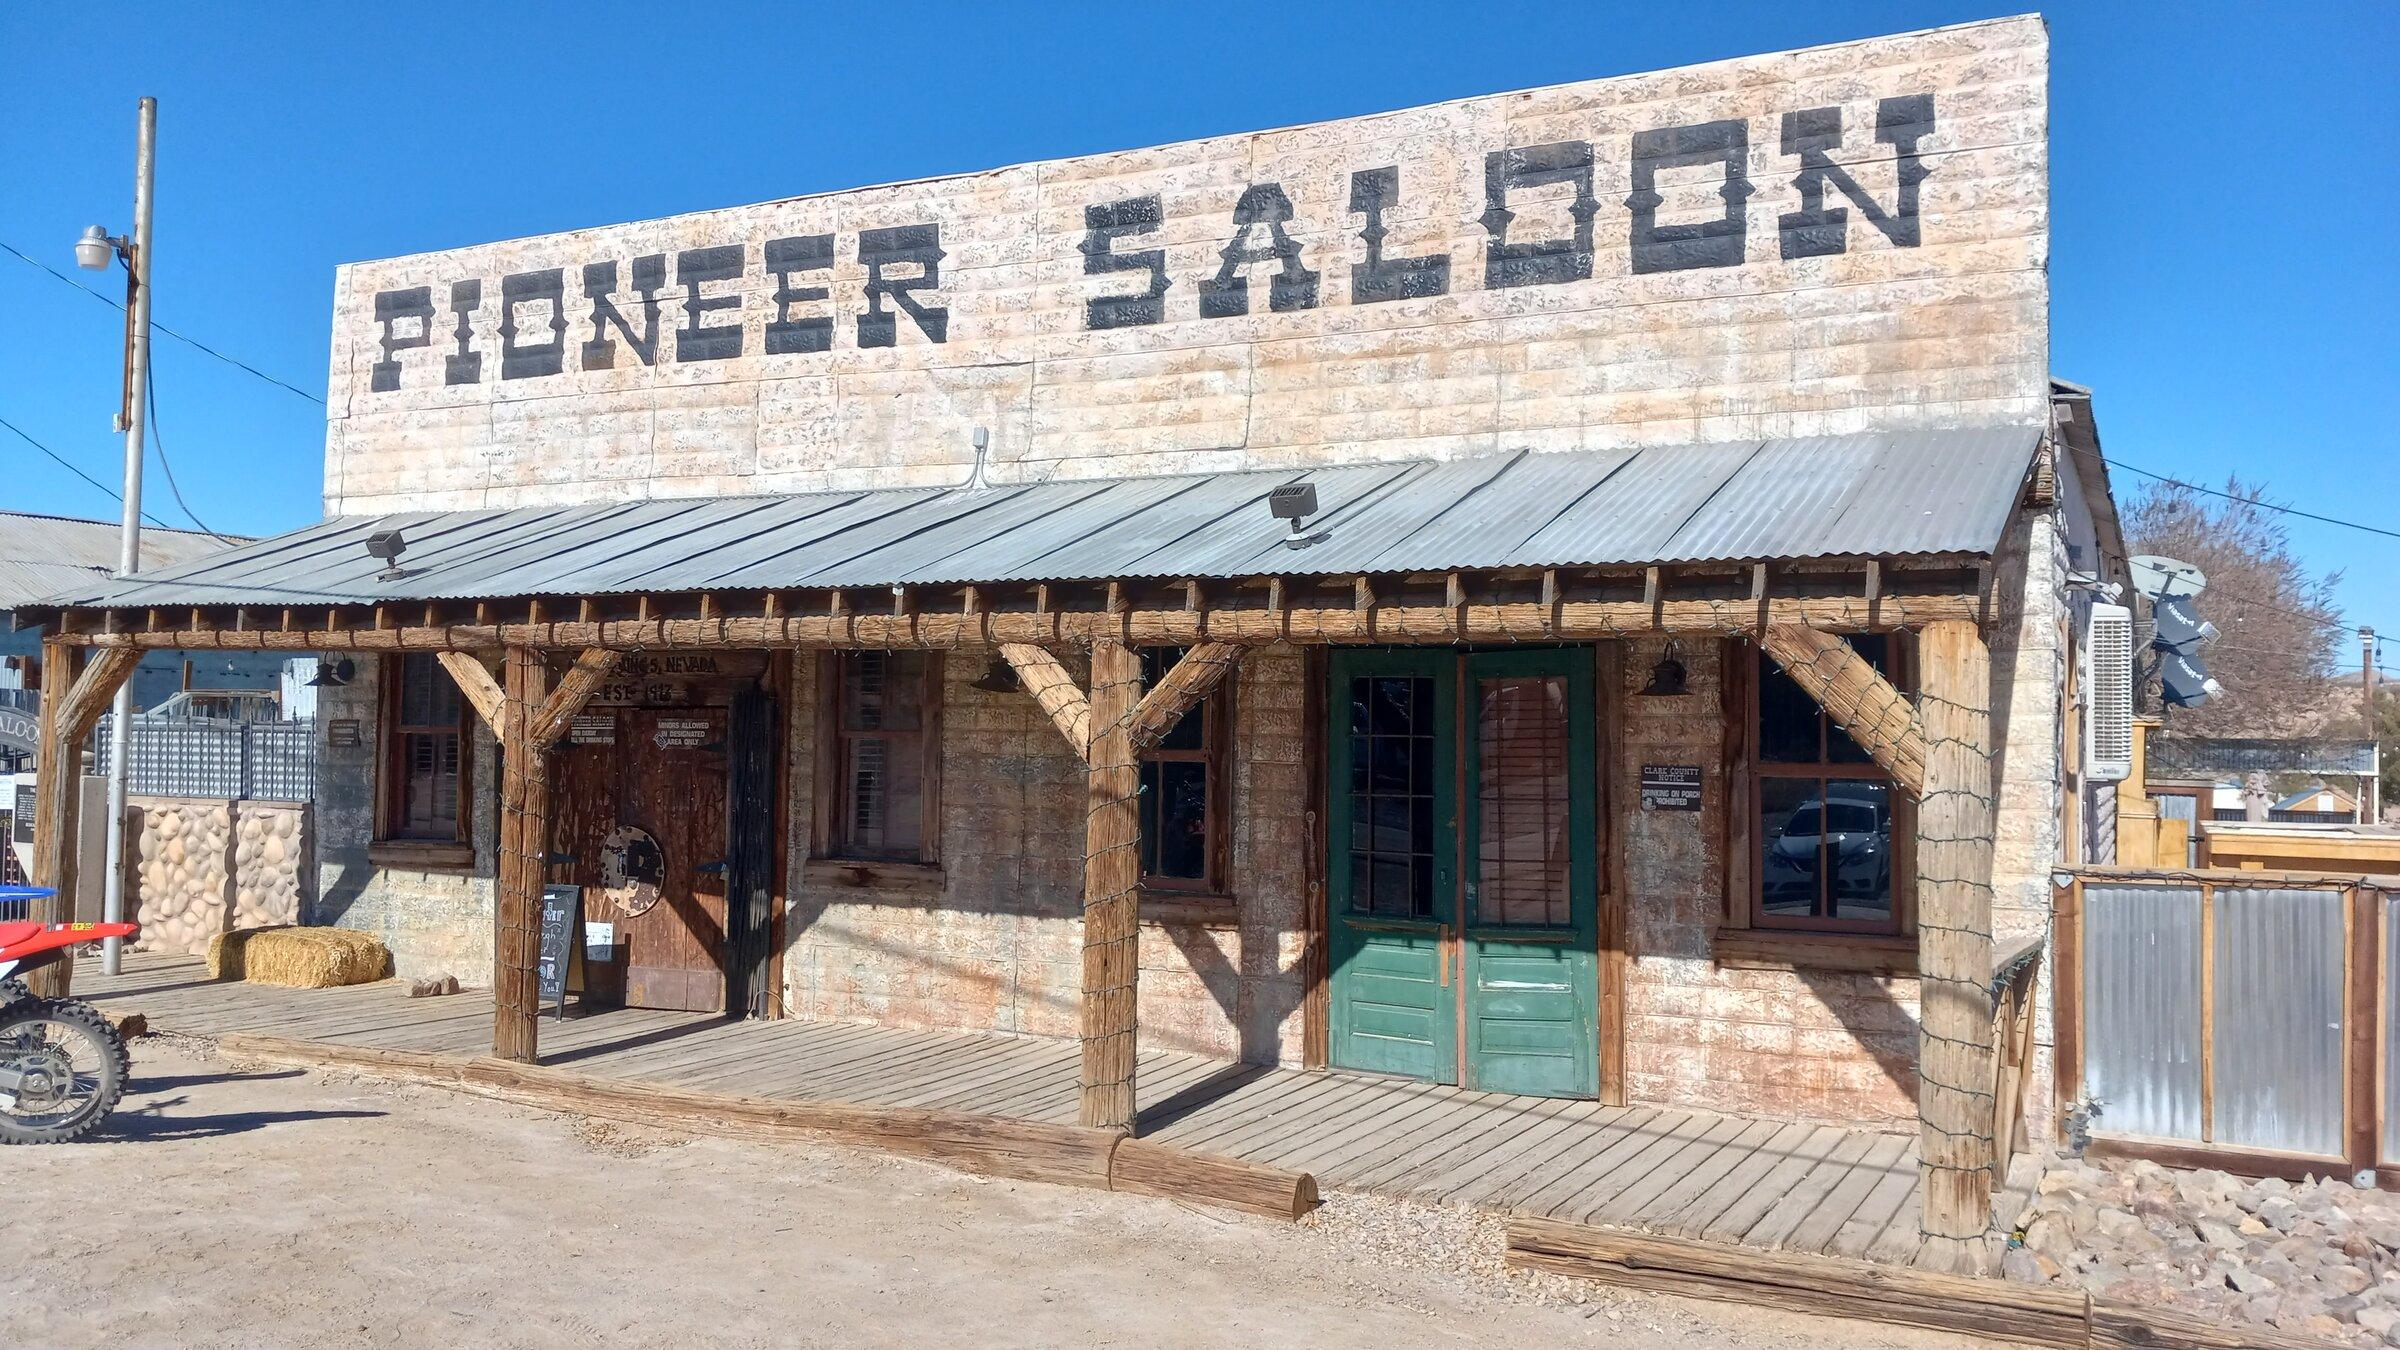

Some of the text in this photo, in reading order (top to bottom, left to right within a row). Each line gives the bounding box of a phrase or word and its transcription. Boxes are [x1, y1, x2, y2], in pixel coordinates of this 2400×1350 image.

[372, 93, 1935, 392] PIONEER SALOON
[669, 730, 705, 738] DESIGNATED
[684, 738, 700, 746] ONLY
[1670, 767, 1699, 776] COUNTY
[1642, 789, 1701, 799] DRINKING ON PORCH
